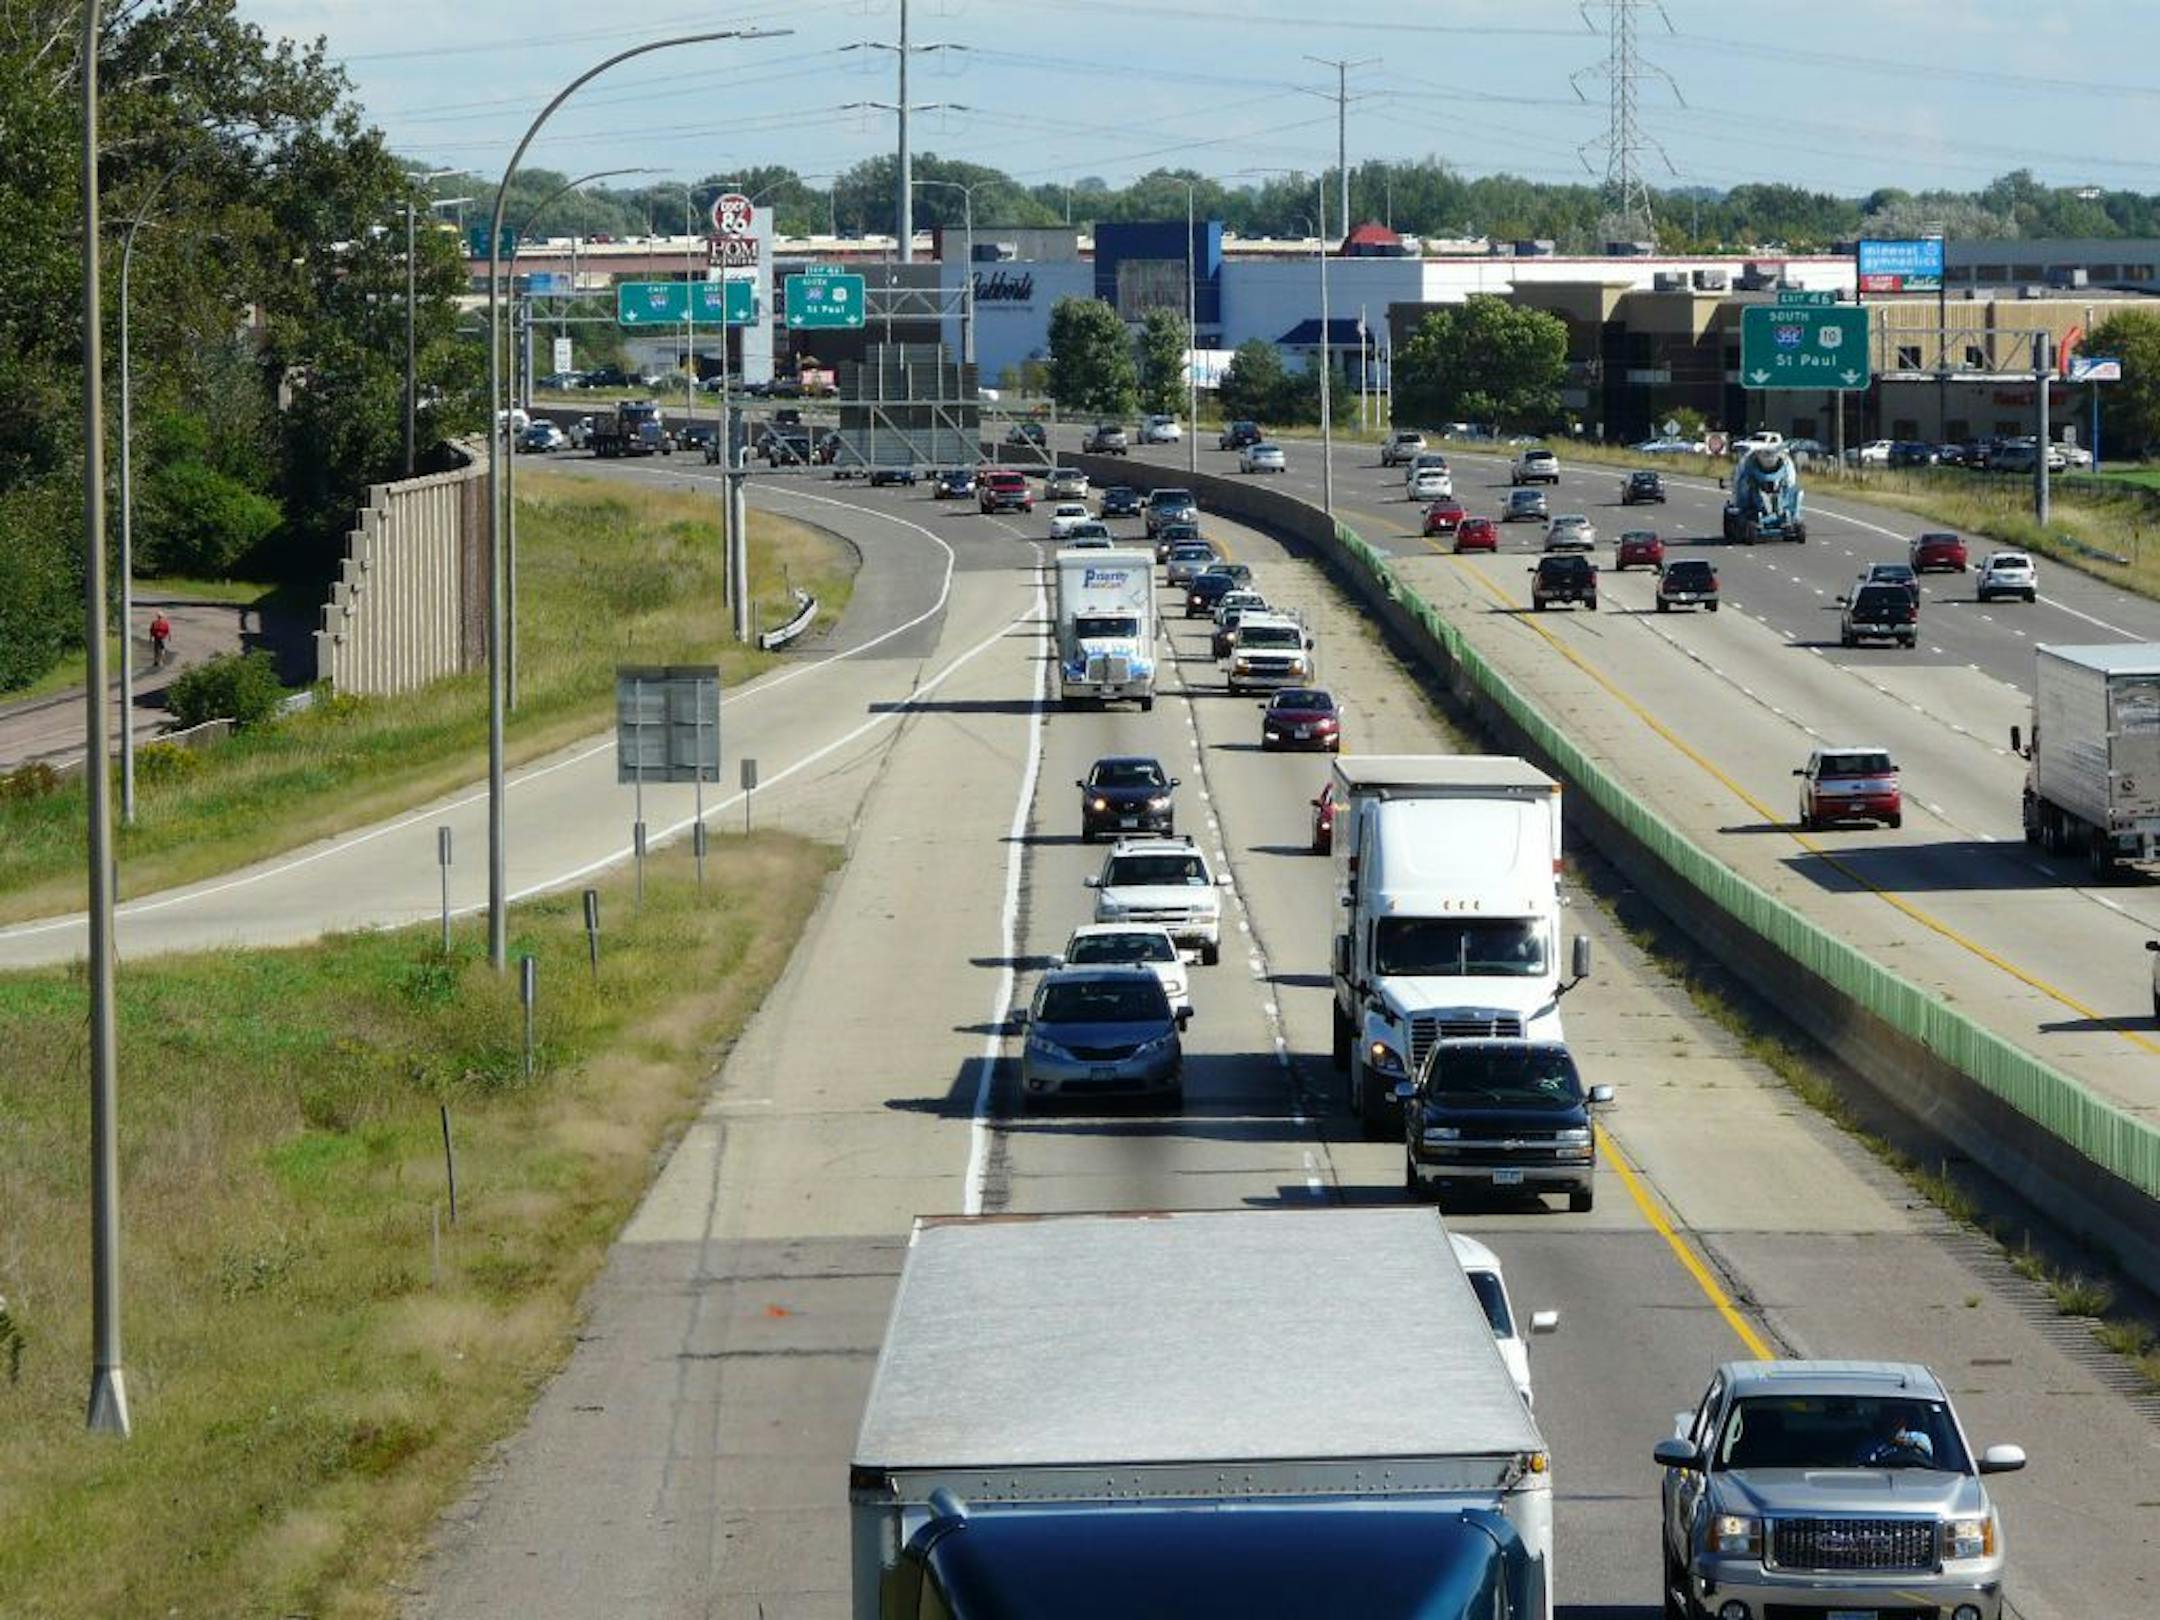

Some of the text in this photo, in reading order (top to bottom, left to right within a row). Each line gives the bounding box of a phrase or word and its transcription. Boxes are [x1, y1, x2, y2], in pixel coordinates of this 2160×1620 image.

[711, 241, 757, 257] HOM
[1780, 293, 1830, 304] EXIT 46
[822, 305, 844, 313] Paul
[1769, 311, 1809, 321] SOUTH
[1823, 331, 1837, 343] 10
[1776, 354, 1836, 366] St Paul
